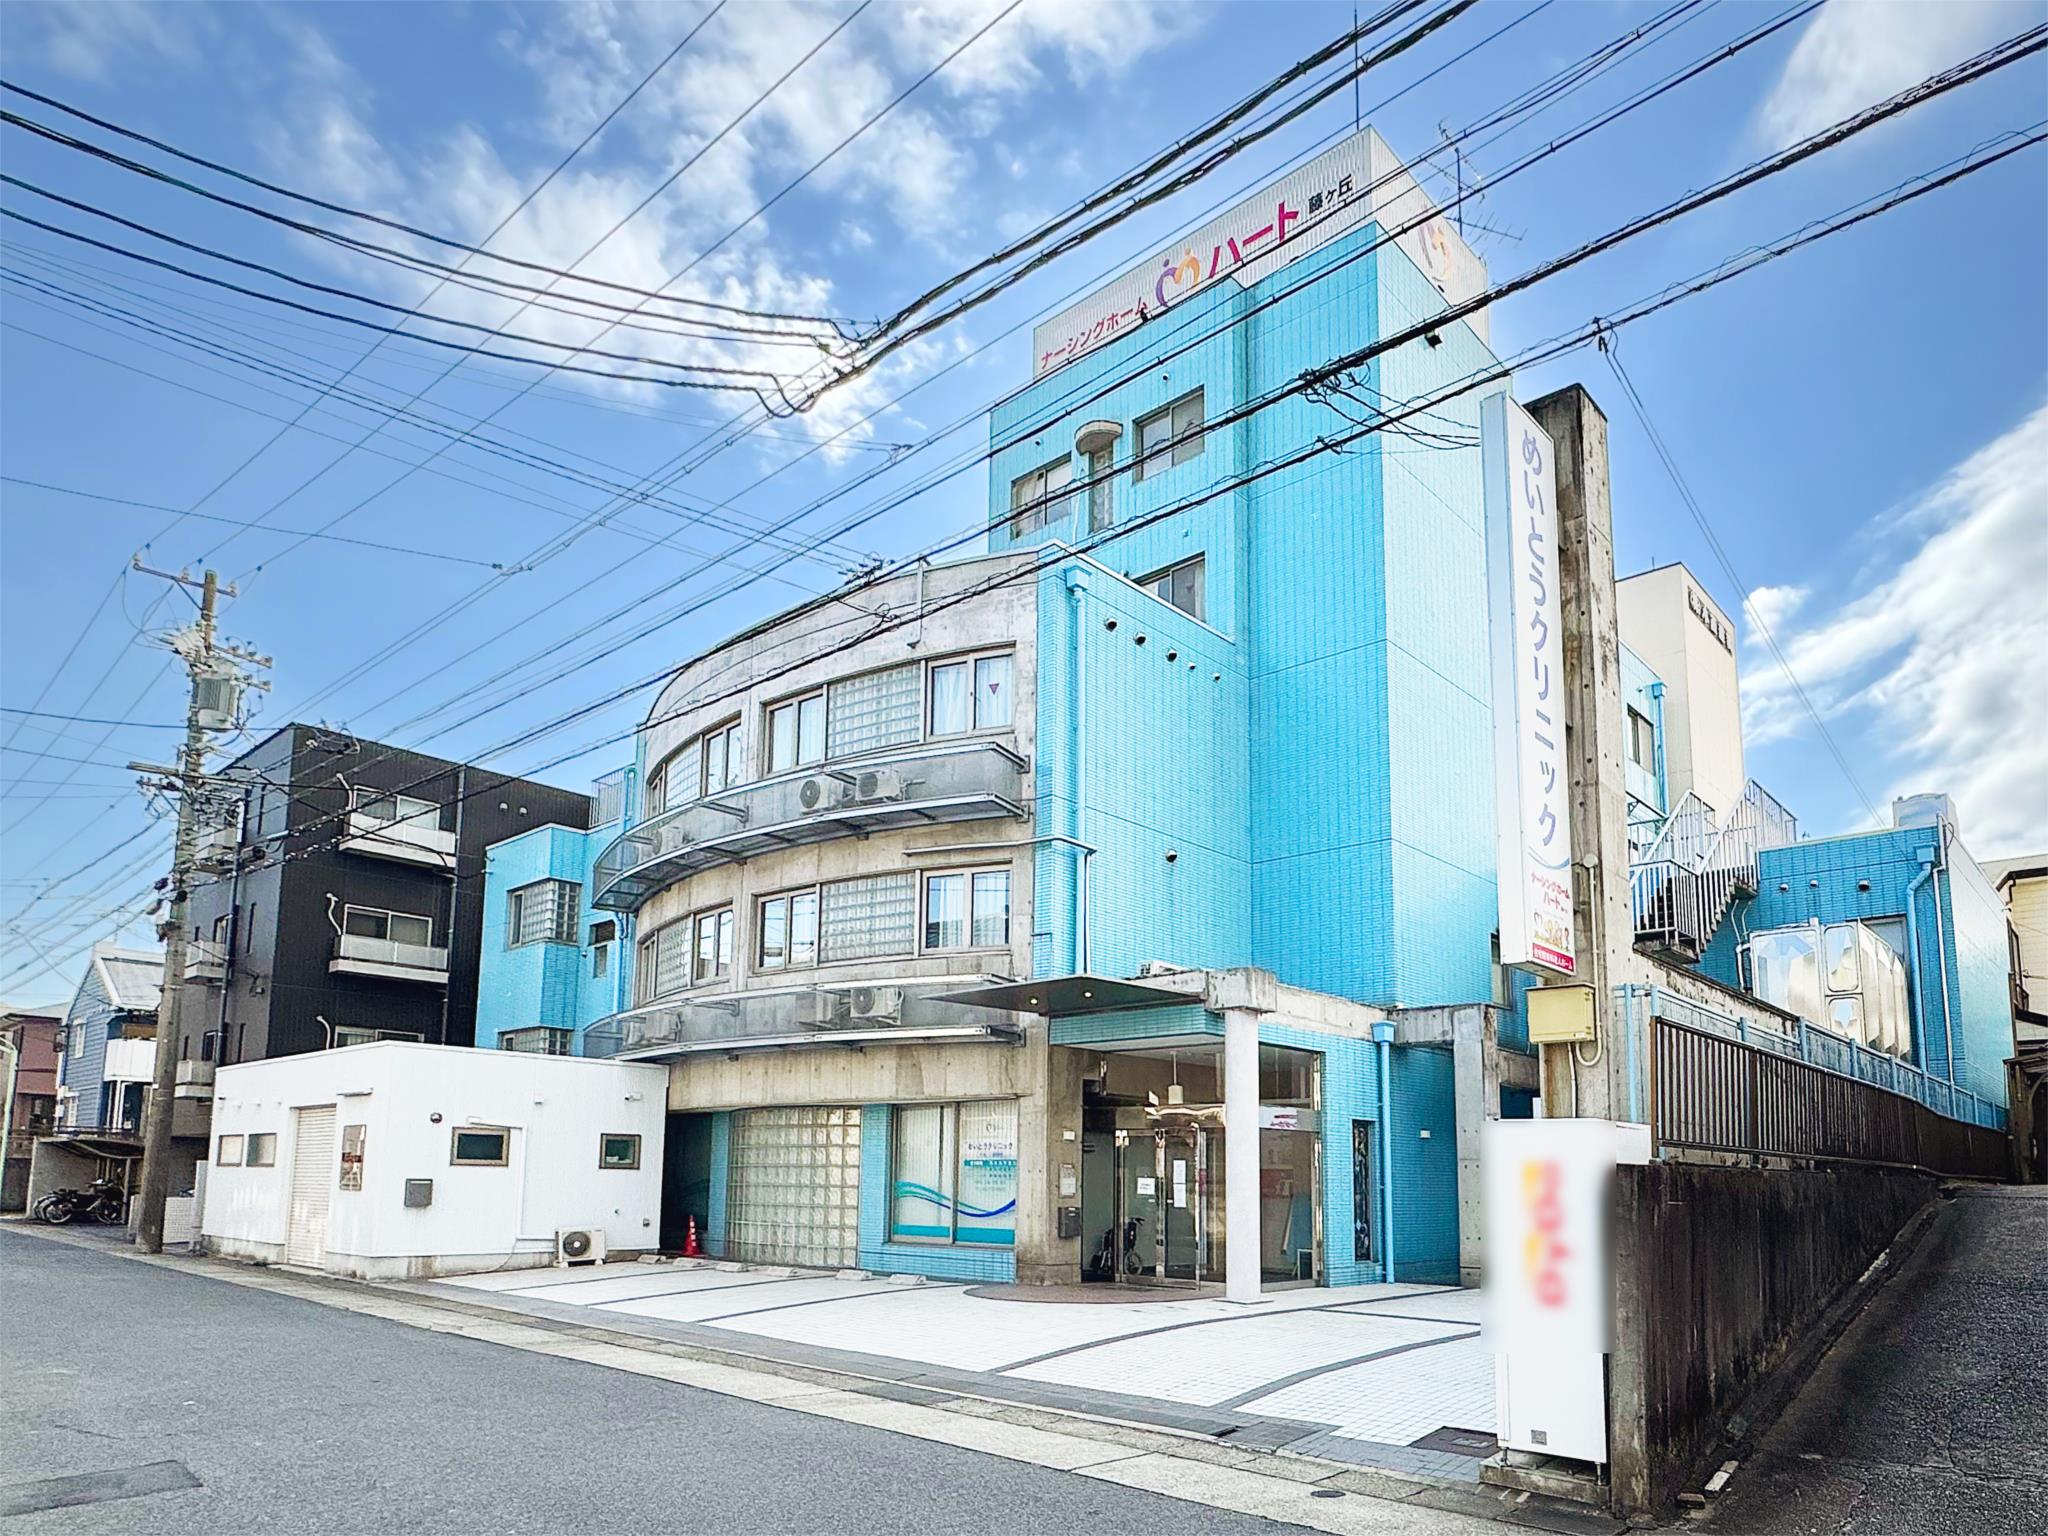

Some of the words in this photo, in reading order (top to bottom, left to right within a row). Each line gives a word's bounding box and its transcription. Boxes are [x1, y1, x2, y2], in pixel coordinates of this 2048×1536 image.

[1041, 296, 1148, 369] ナーシングホーム
[1208, 200, 1299, 279] ハート
[1522, 428, 1557, 847] めいとうクリニック
